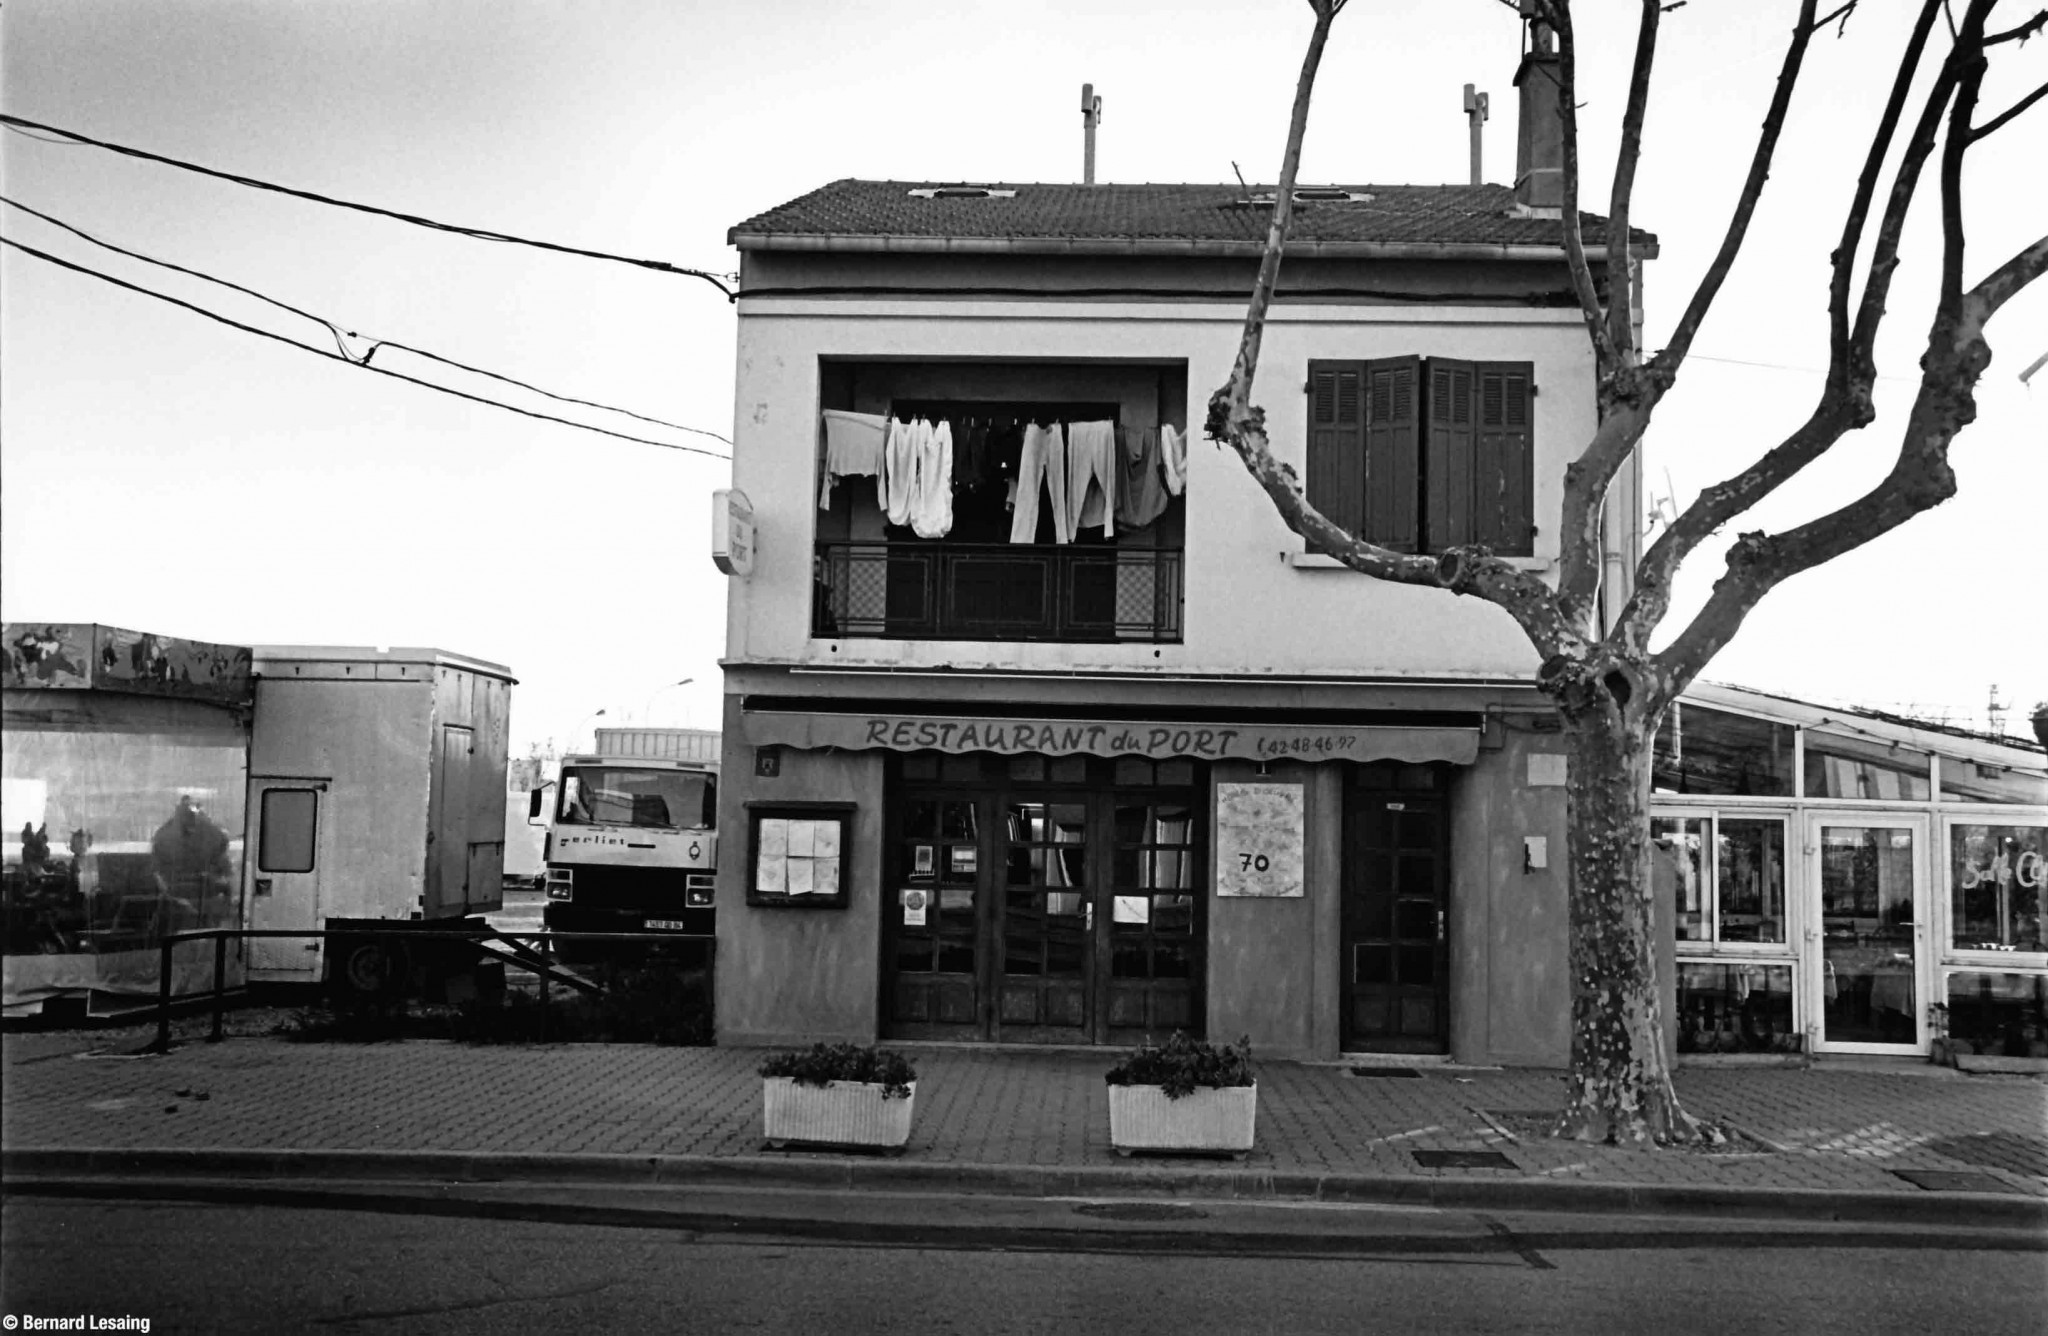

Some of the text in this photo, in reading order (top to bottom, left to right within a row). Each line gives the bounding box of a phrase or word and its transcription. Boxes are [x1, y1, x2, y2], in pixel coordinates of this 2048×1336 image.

[865, 719, 1107, 751] RESTAURANT
[1110, 731, 1142, 751] du
[1145, 728, 1239, 755] PORT
[1239, 852, 1270, 872] 70
